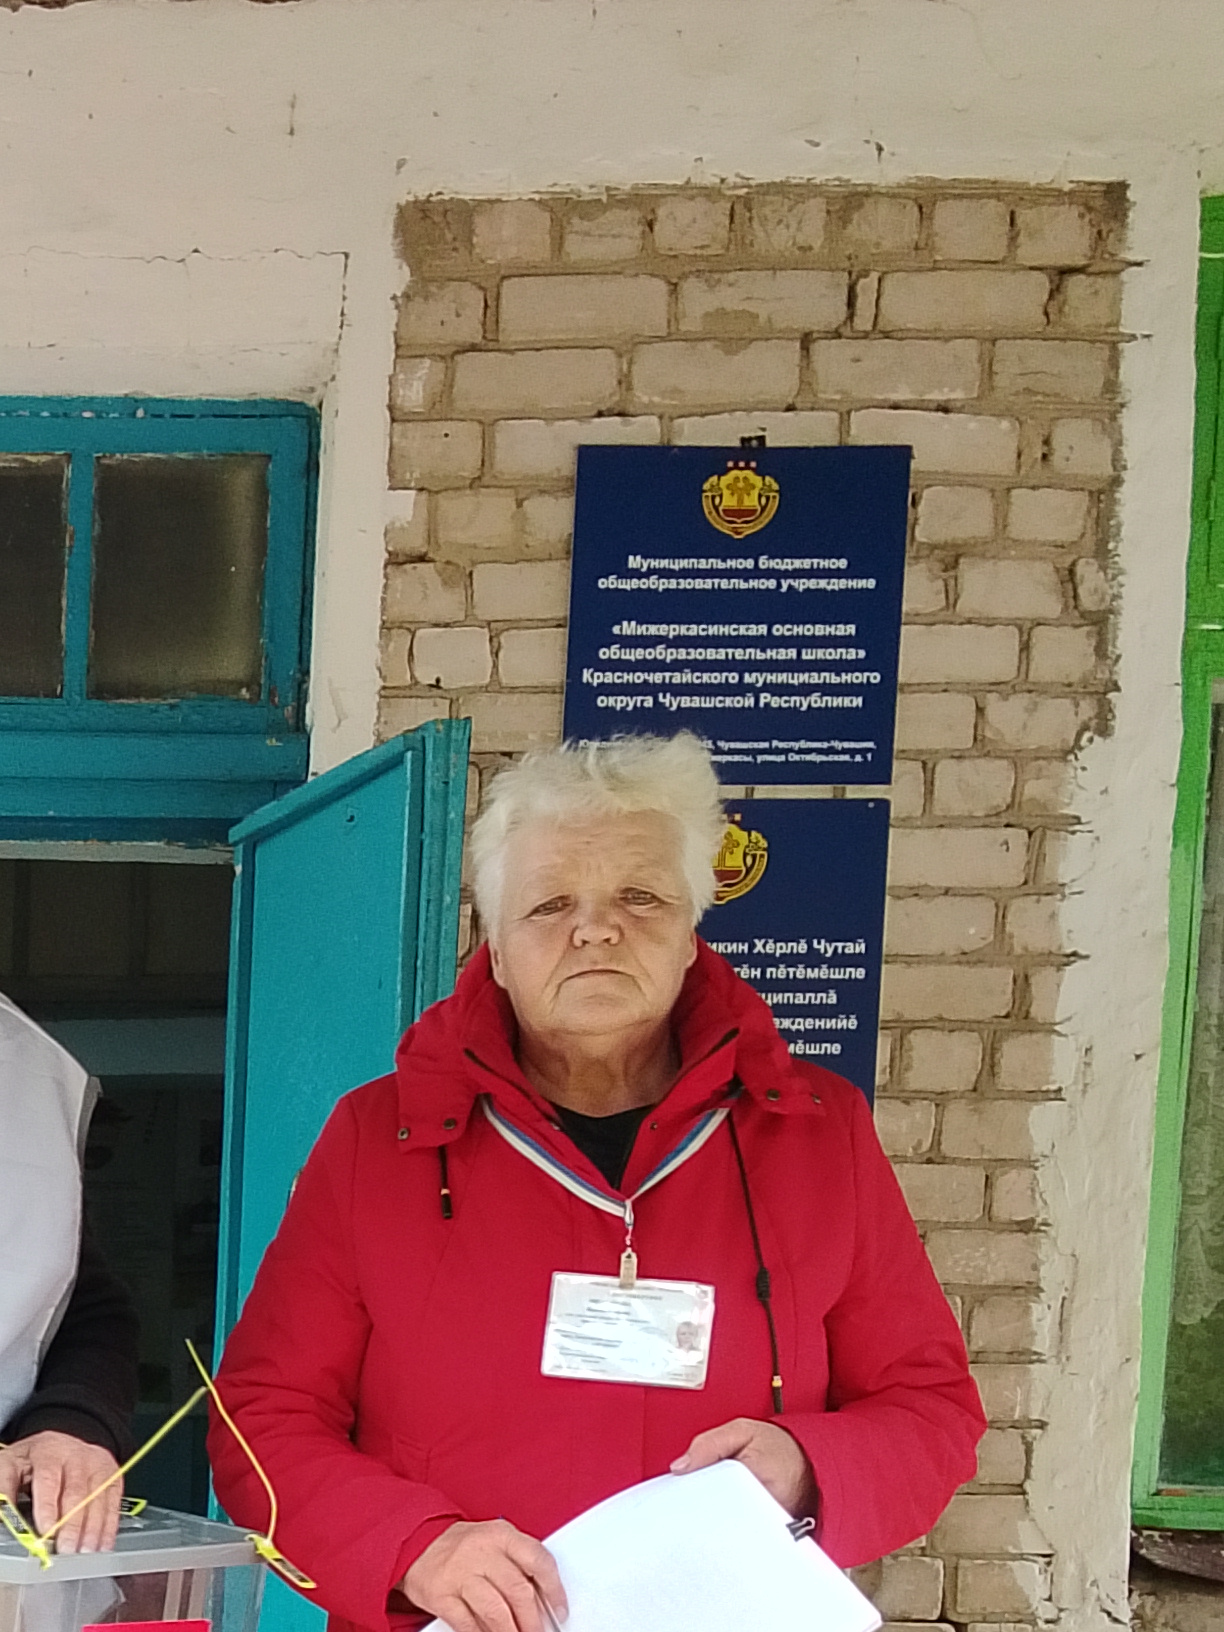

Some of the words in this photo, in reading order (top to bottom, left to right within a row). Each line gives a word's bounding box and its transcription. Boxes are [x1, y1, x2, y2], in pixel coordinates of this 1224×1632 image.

[627, 555, 755, 572] Муниципальное
[758, 555, 848, 571] бюджетное
[597, 574, 777, 592] общеобразовательное
[779, 578, 877, 592] учреждение
[611, 620, 768, 640] «Мижеркасинская
[771, 623, 856, 637] основная
[598, 643, 798, 663] общеобразовательная
[801, 647, 867, 661] школа»
[582, 667, 740, 686] Красночетайского
[596, 695, 654, 711] округа
[658, 692, 755, 712] Чувашской
[759, 692, 863, 712] Республики
[812, 938, 866, 958] Чутай
